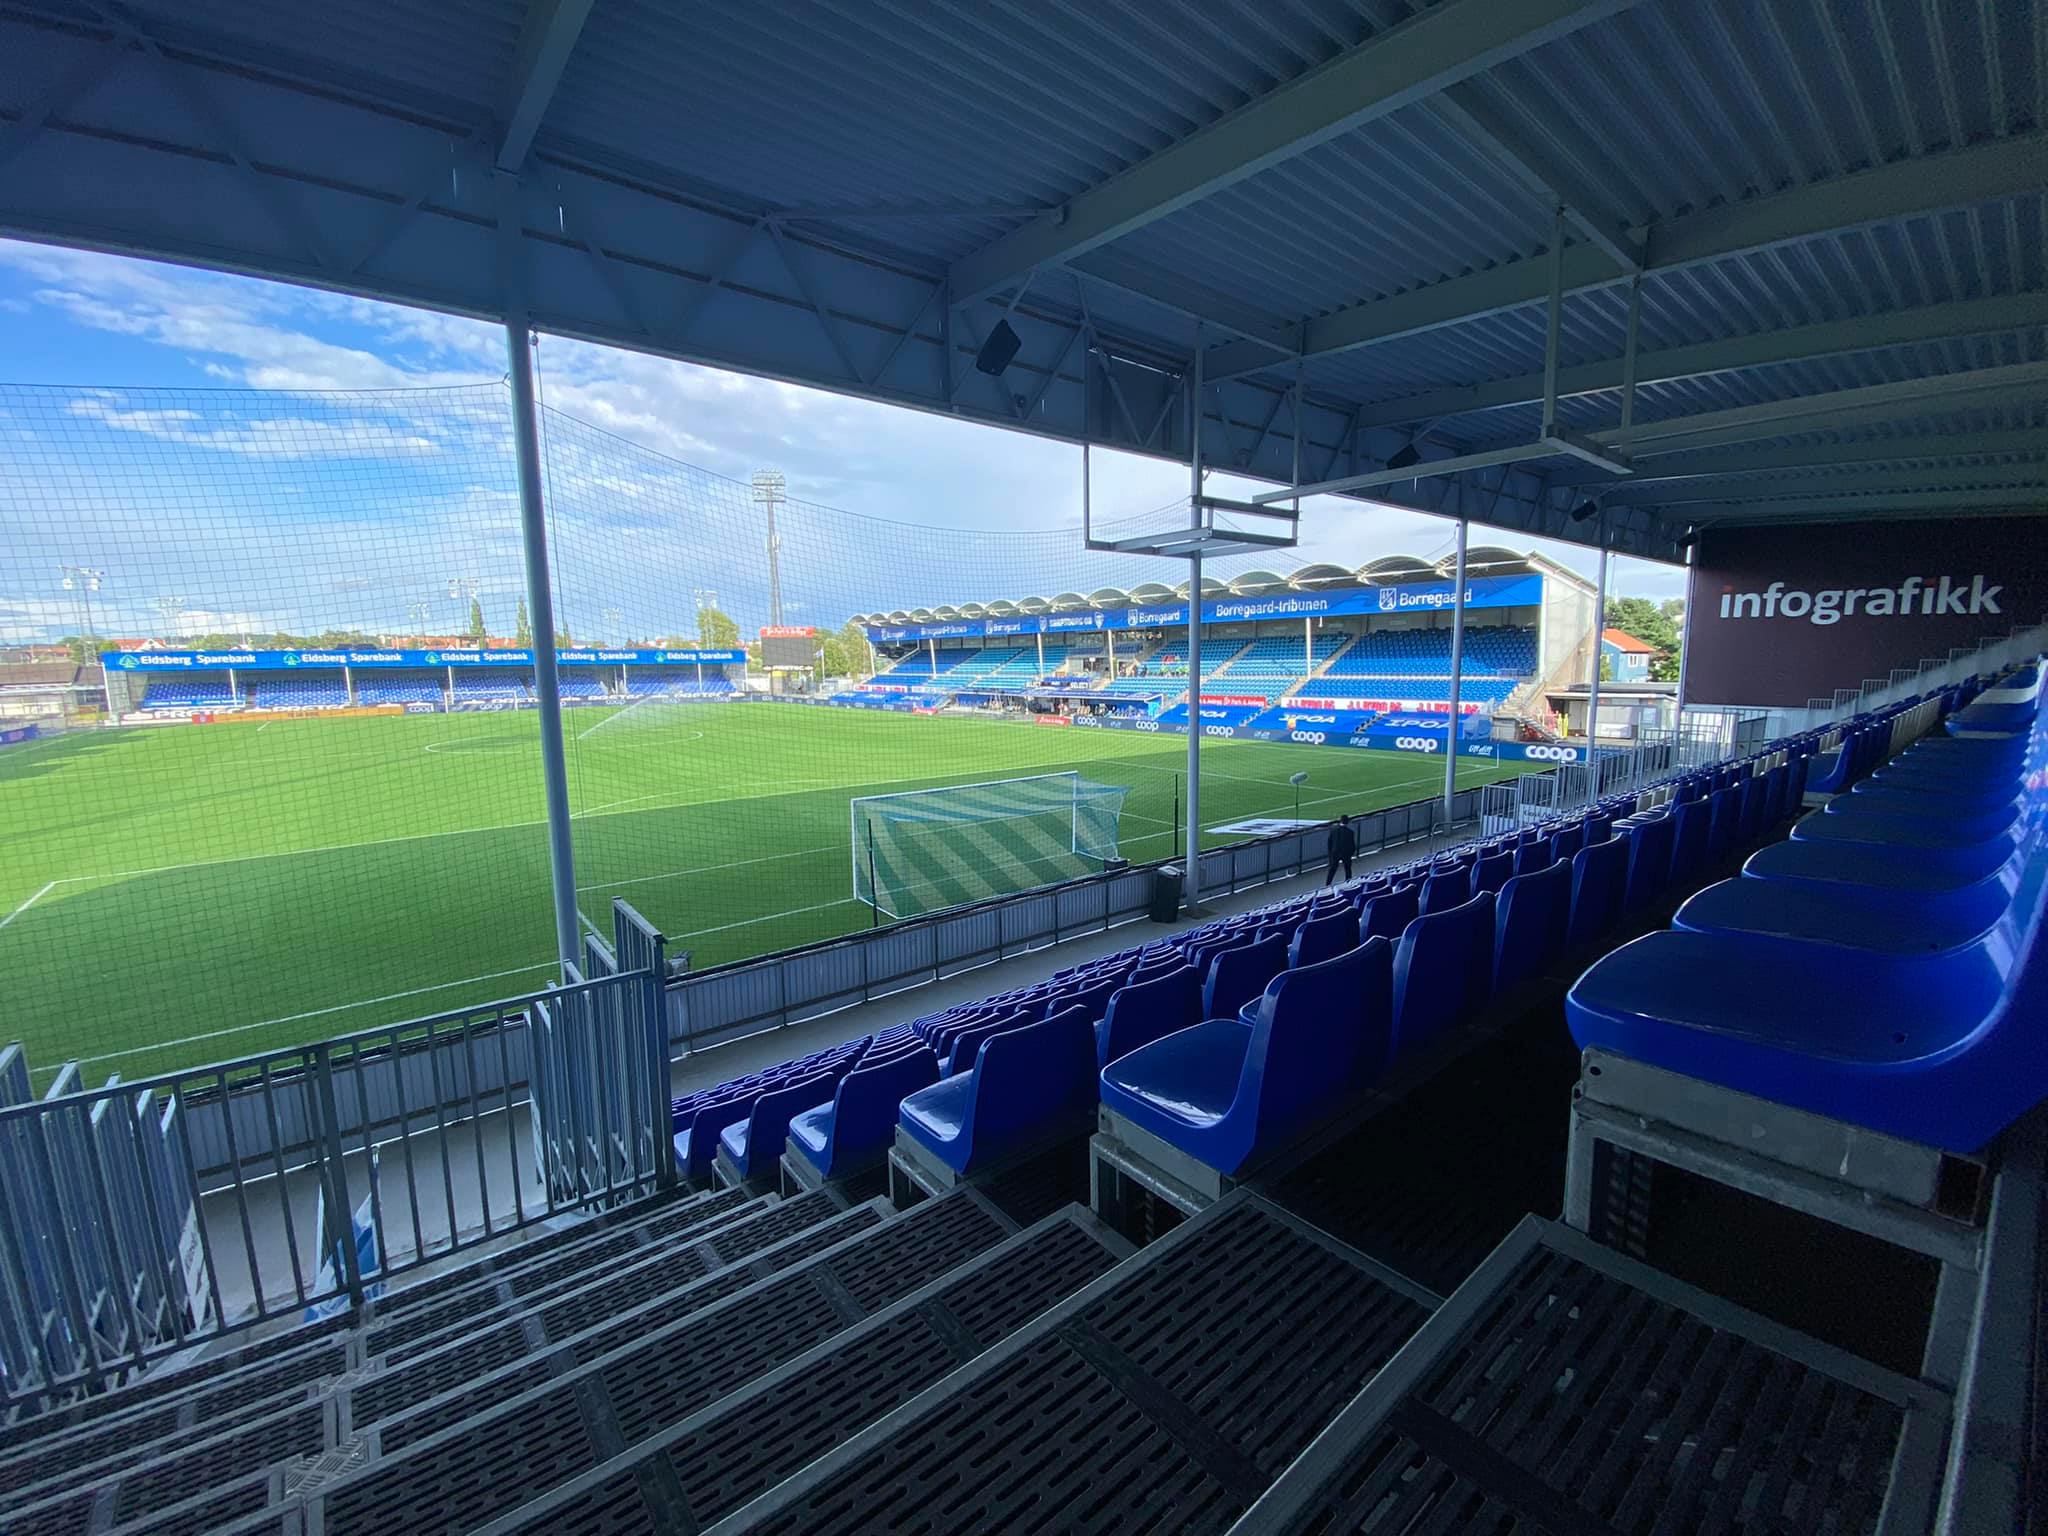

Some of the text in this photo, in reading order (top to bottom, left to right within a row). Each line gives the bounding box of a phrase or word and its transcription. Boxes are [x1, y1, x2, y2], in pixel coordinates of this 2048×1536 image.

[1399, 588, 1472, 607] Borregaad
[1719, 575, 2004, 625] infografikk
[1216, 599, 1328, 618] Borregaard-tribunen
[1139, 611, 1180, 624] Borregaard
[140, 654, 256, 666] Eidsberg Sparebank
[301, 653, 402, 663] Eidsberg Sparebank
[441, 652, 528, 662] Eidsberg Sparebank
[1078, 716, 1097, 727] coop
[1136, 720, 1159, 732] coop
[1206, 725, 1234, 738] coop
[1291, 730, 1326, 745] coop
[1395, 737, 1438, 752] coop
